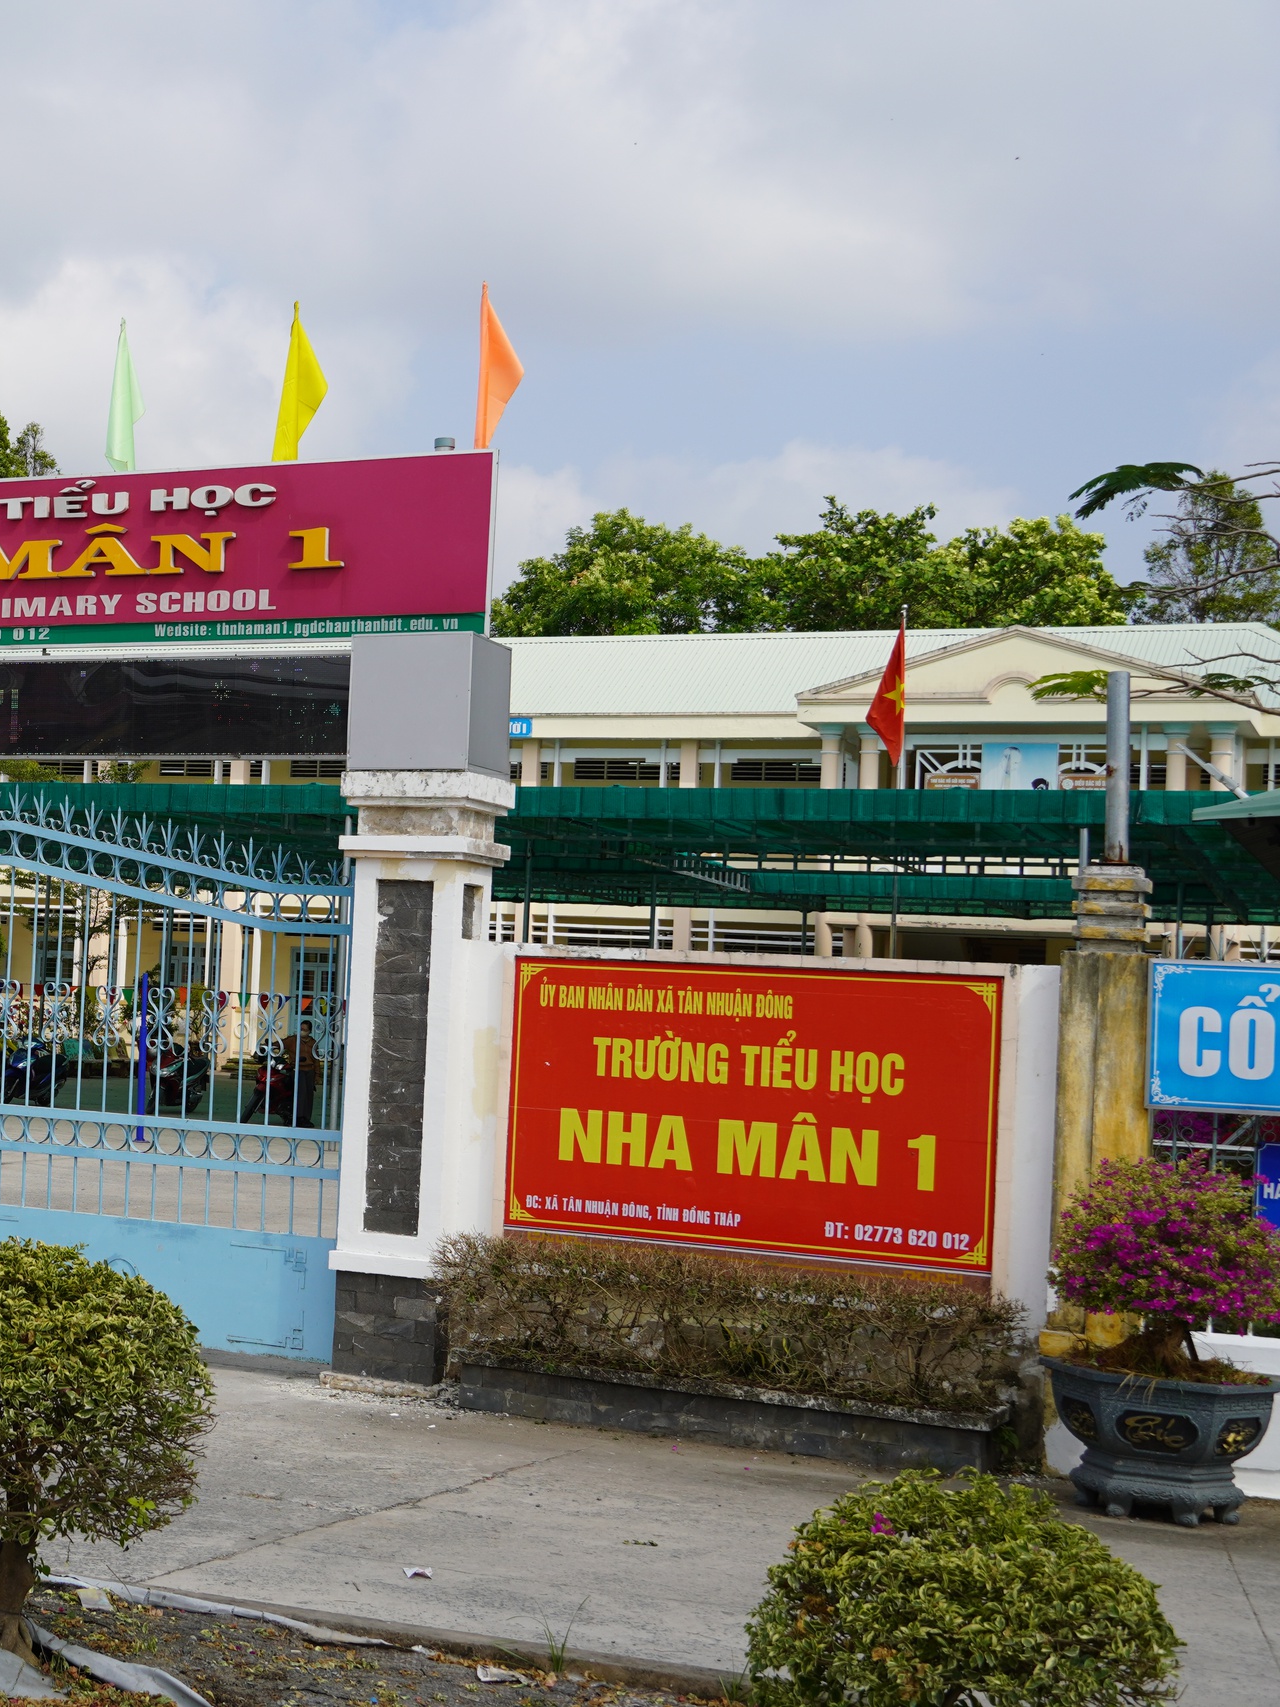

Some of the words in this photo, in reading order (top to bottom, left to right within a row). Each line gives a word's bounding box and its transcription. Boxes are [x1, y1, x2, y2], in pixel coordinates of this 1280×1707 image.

[149, 483, 276, 517] HỌC
[288, 526, 344, 570] 1
[135, 589, 276, 614] SCHOOL
[12, 628, 50, 641] 012
[154, 624, 212, 637] Wedsite:
[540, 977, 555, 1007] ỦY
[559, 986, 584, 1008] BAN
[588, 983, 623, 1010] NHÂN
[626, 984, 653, 1012] DÂN
[656, 986, 674, 1013] XÃ
[678, 986, 702, 1015] TÂN
[706, 988, 752, 1022] NHUẬN
[756, 990, 793, 1019] ĐÔNG
[593, 1030, 729, 1084] TRƯỜNG
[740, 1030, 818, 1091] TIỂU
[830, 1050, 905, 1104] HỌC
[558, 1107, 692, 1172] NHA
[716, 1112, 880, 1187] MÂN
[906, 1134, 936, 1192] 1
[526, 1194, 542, 1209] ĐC:
[545, 1194, 558, 1210] XÃ
[562, 1196, 582, 1212] TÂN
[585, 1199, 619, 1218] NHUẬN
[622, 1200, 652, 1221] ĐÔNG,
[682, 1206, 710, 1225] ĐỒNG
[714, 1210, 741, 1227] THÁP
[824, 1222, 848, 1239] ĐT:
[854, 1224, 902, 1244] 02773
[908, 1228, 937, 1248] 620
[942, 1232, 970, 1250] 012
